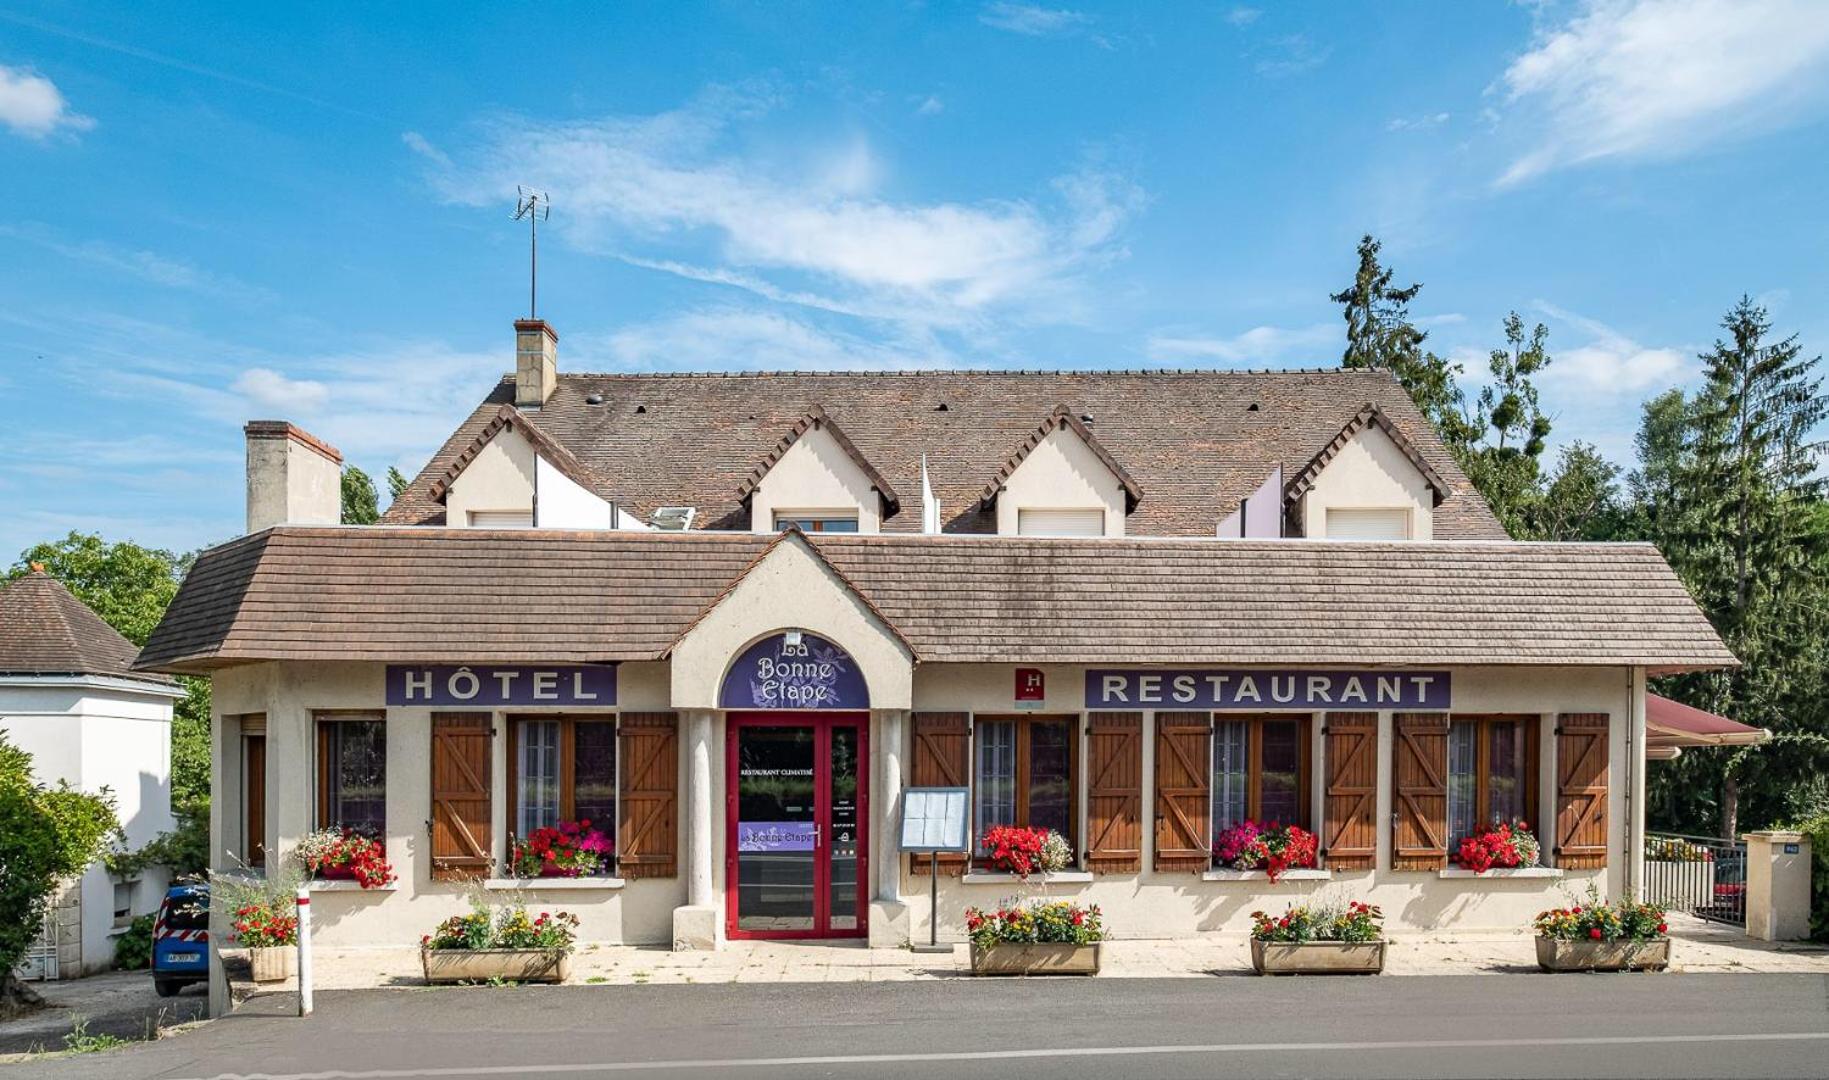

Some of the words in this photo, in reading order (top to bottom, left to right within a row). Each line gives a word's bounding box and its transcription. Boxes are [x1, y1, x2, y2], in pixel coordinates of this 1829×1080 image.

[782, 637, 809, 657] La
[758, 657, 832, 679] Bonne
[405, 666, 598, 700] HÔTEL
[1028, 673, 1040, 687] H
[1102, 675, 1434, 703] RESTAURANT
[762, 680, 828, 704] Etape
